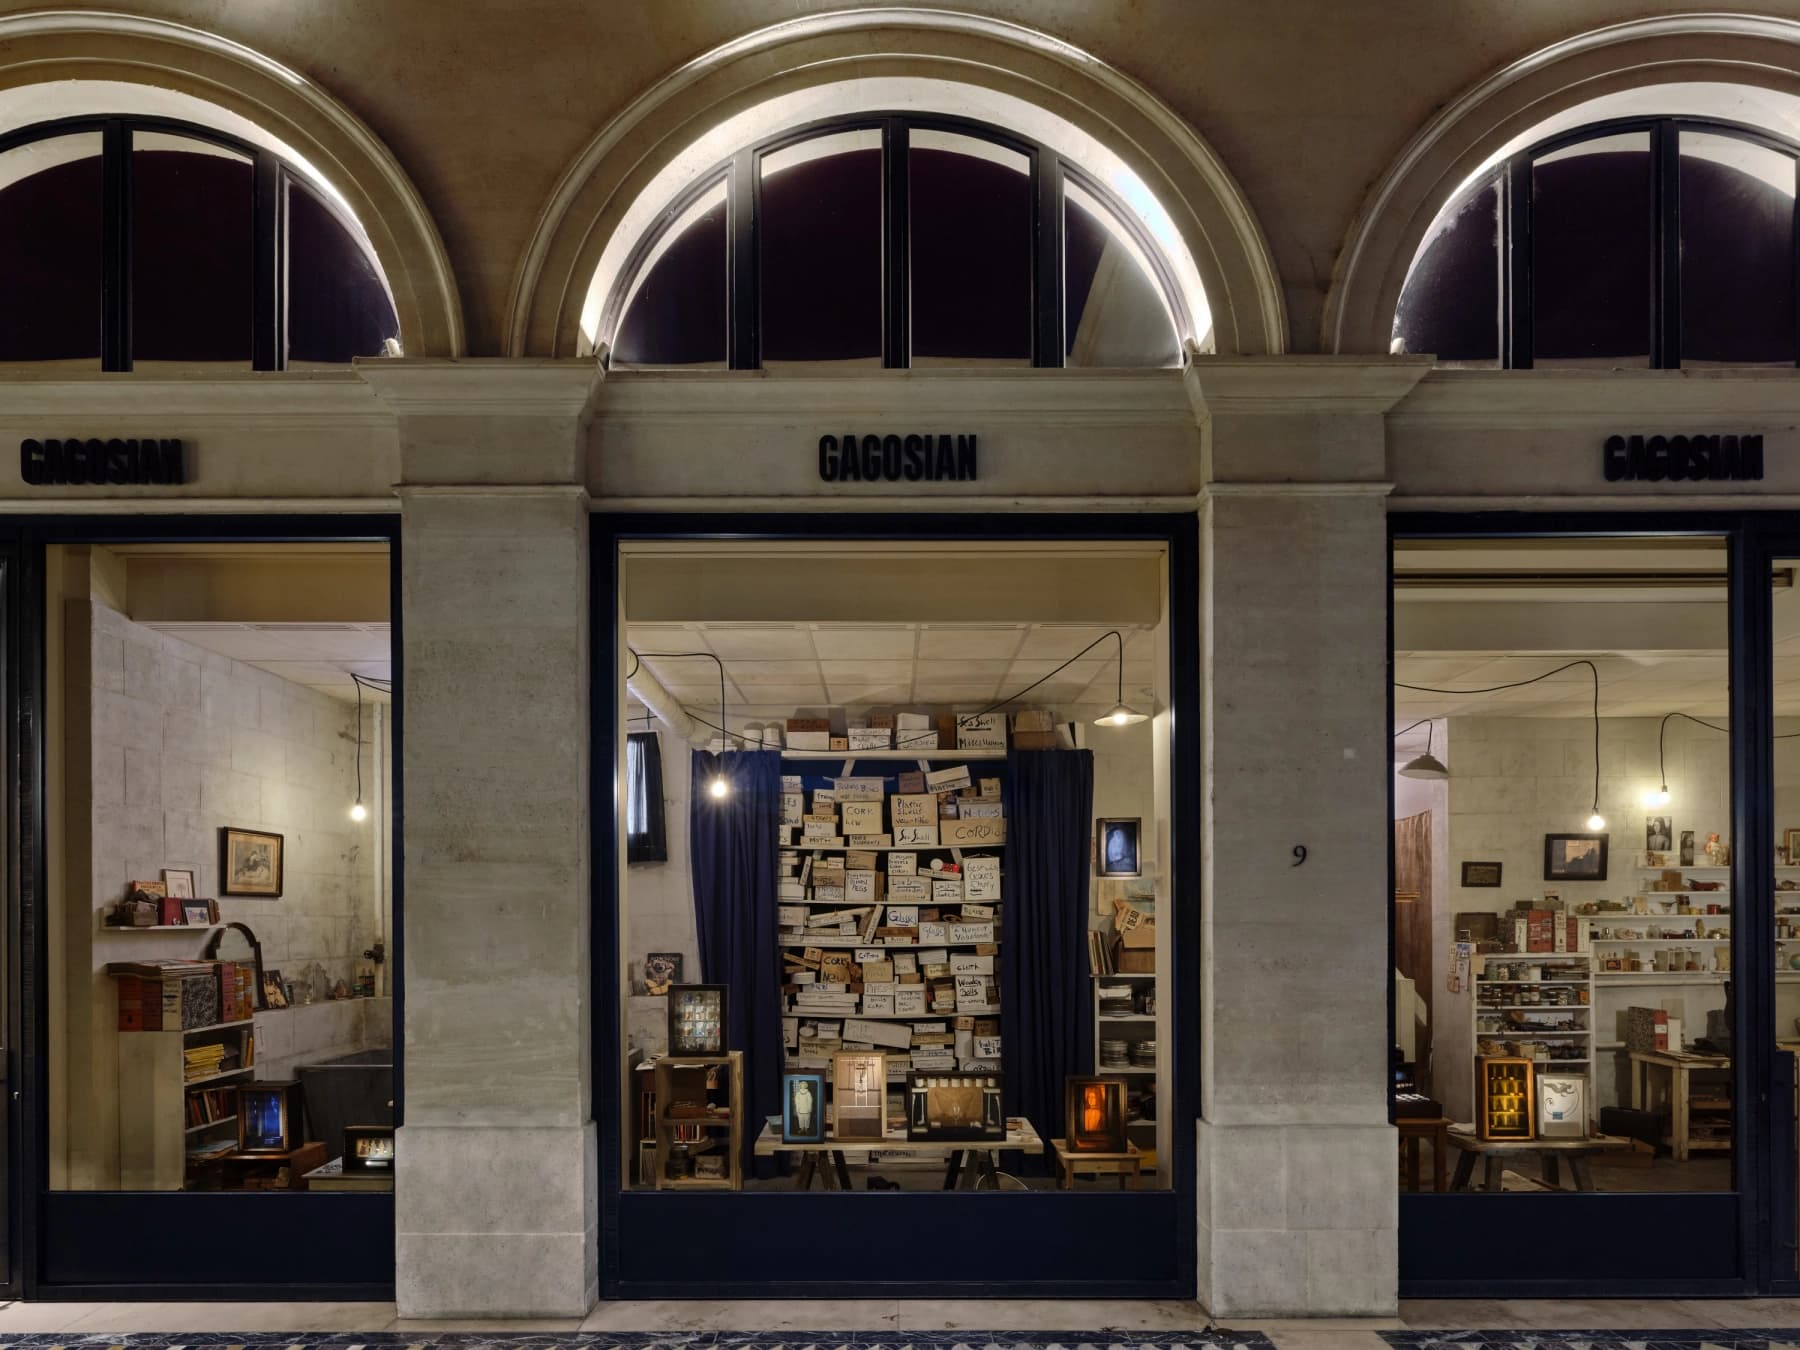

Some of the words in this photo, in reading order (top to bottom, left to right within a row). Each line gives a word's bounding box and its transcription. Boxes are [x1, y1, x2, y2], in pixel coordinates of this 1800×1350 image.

[20, 438, 183, 485] GAGOSIAN
[818, 434, 977, 481] GAGOSIAN
[1604, 434, 1764, 482] GAGOSIAN
[1292, 845, 1307, 867] 9
